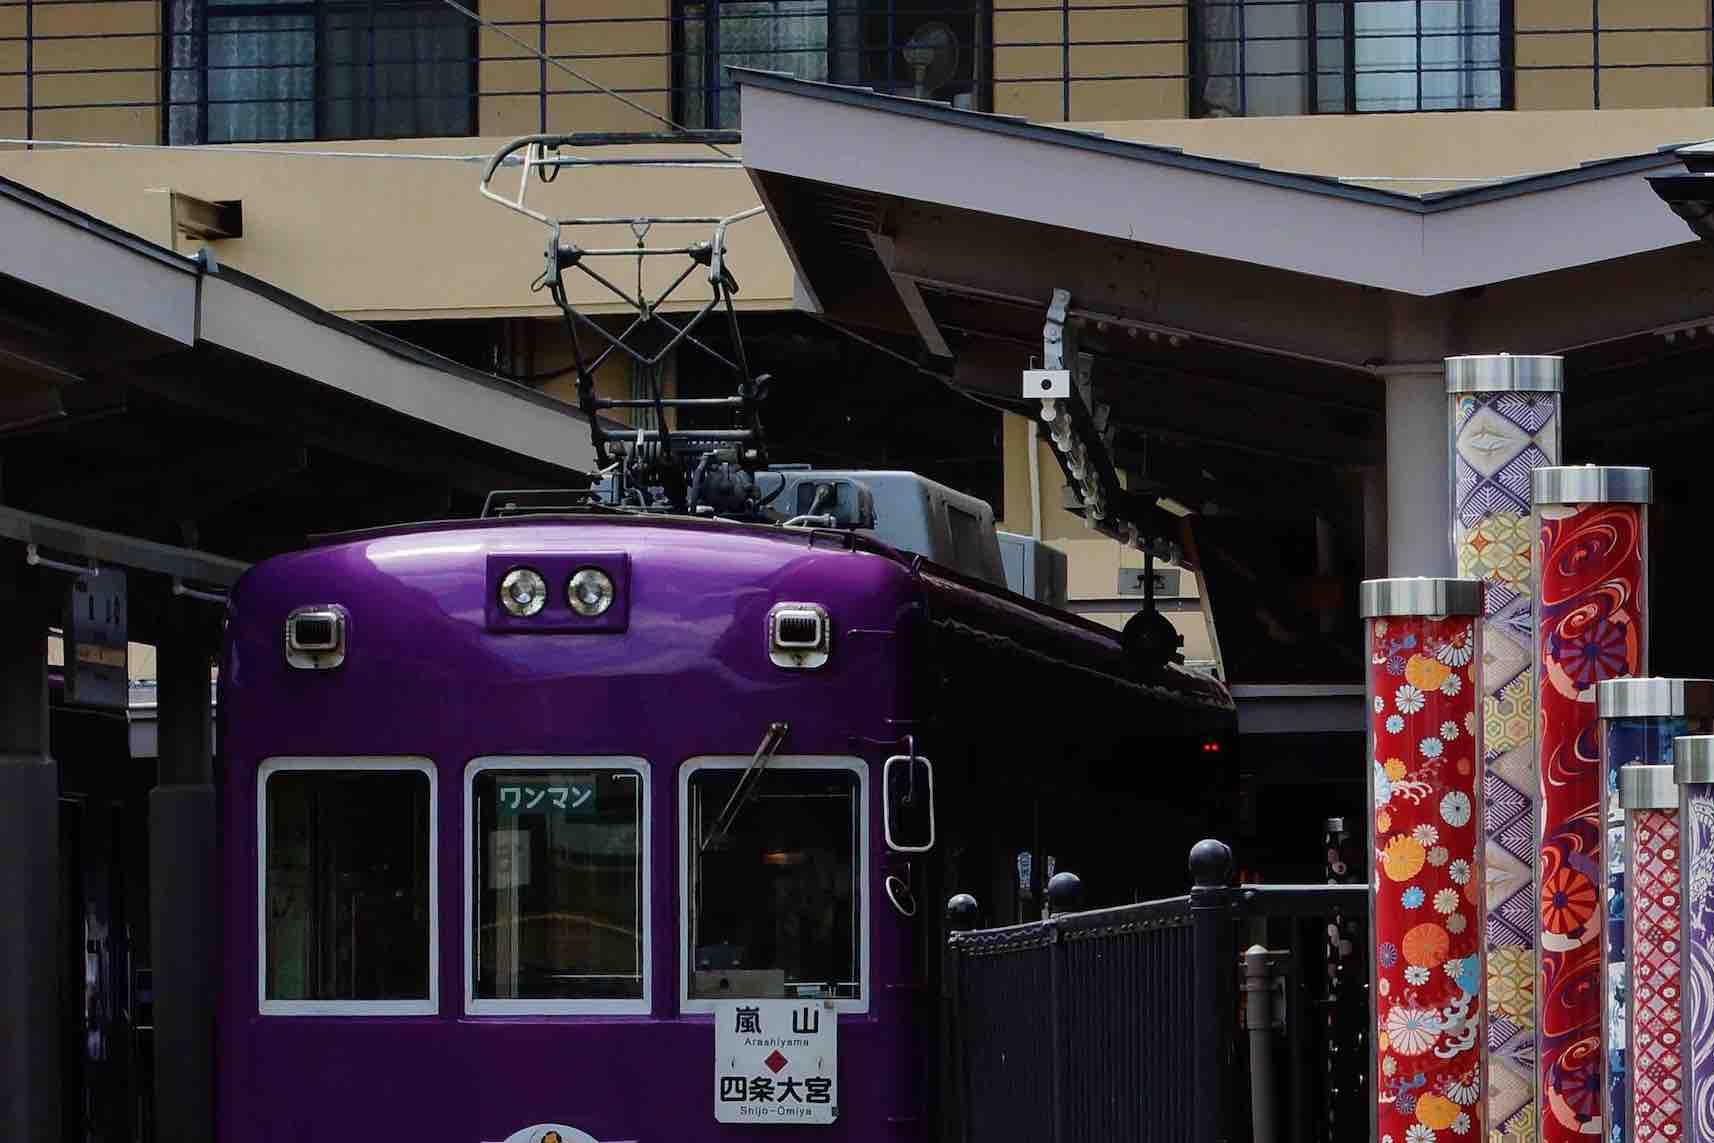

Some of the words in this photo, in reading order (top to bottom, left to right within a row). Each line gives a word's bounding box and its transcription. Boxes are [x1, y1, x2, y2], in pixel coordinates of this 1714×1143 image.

[499, 786, 593, 809] ワンマン
[735, 1006, 819, 1034] 嵐山
[743, 1037, 809, 1048] Arashiyama
[720, 1076, 832, 1104] 四条大宮
